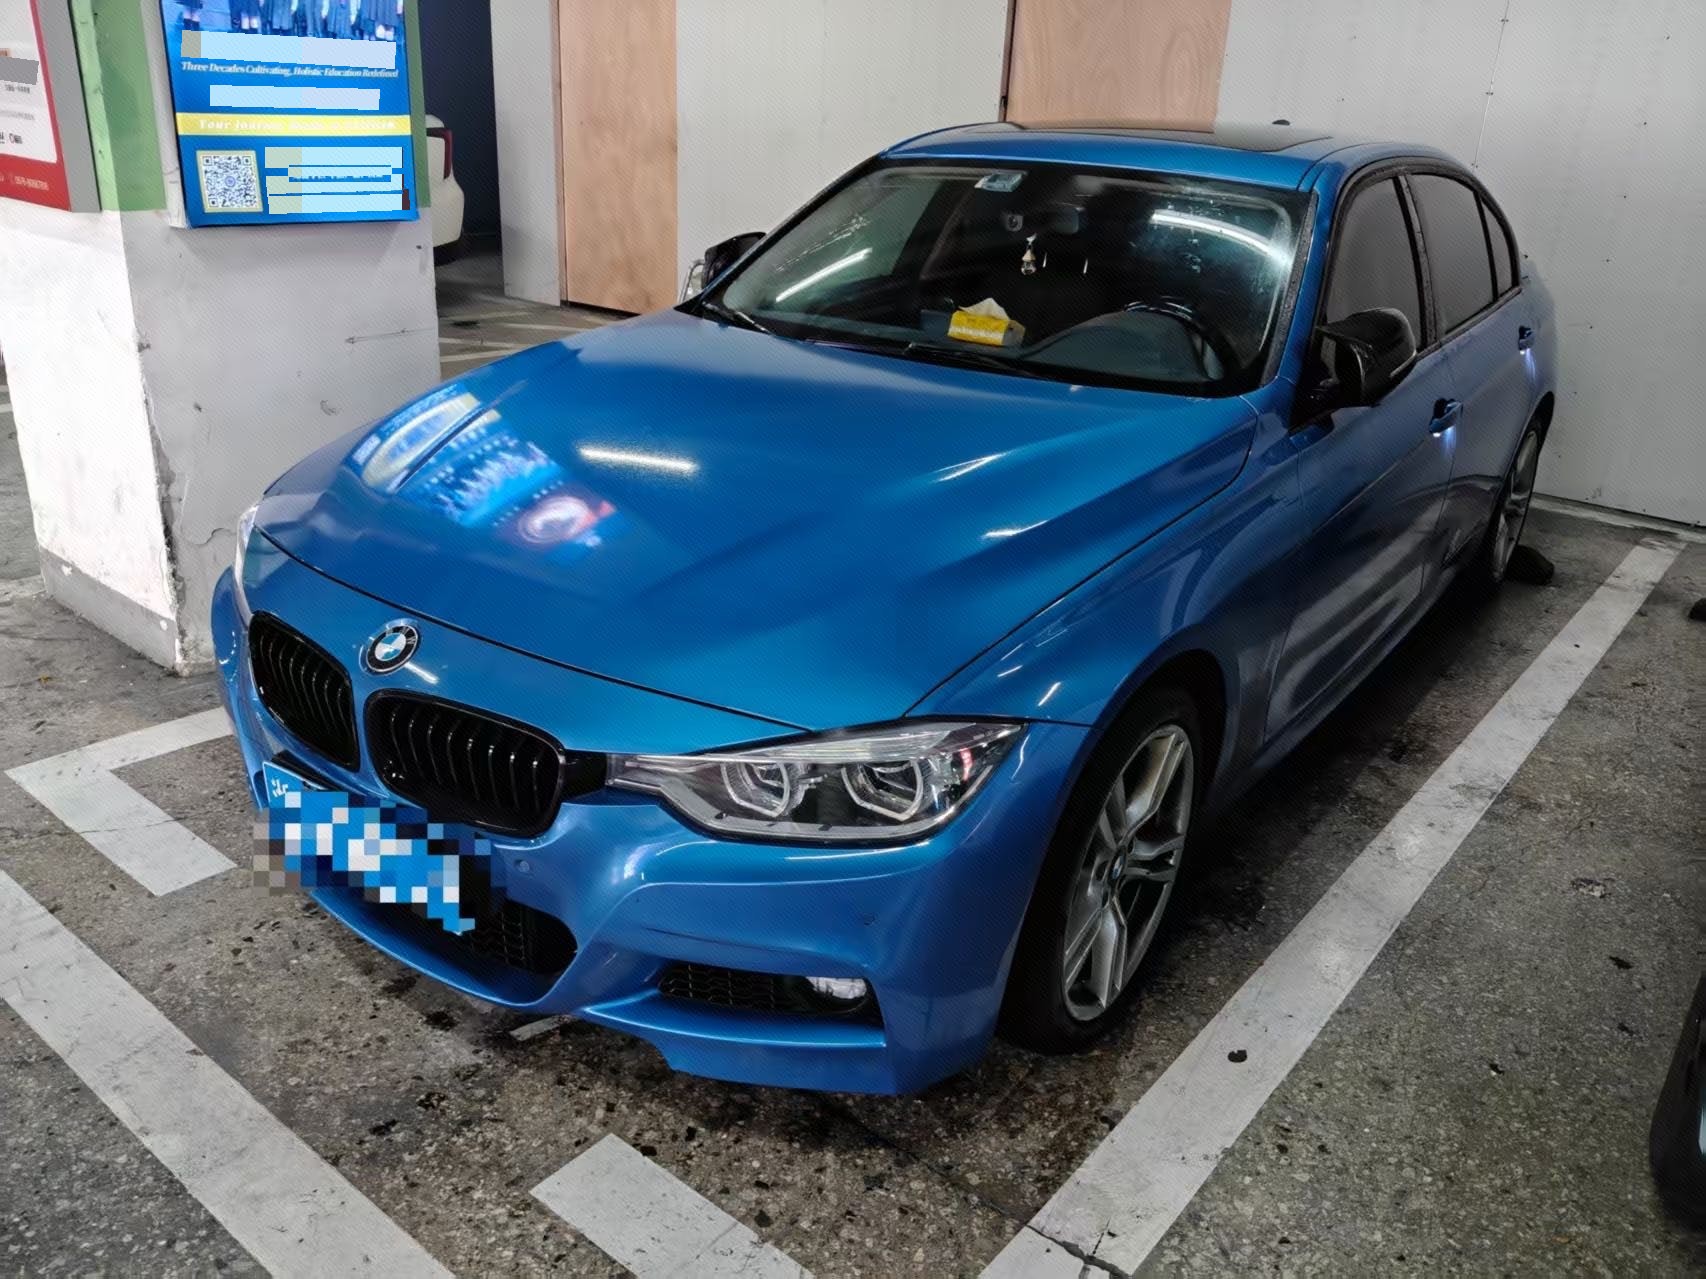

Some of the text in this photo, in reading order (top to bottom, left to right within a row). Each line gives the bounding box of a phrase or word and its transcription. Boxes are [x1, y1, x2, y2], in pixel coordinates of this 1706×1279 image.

[181, 61, 208, 72] Three
[209, 63, 245, 74] Decades
[324, 67, 361, 77] Education
